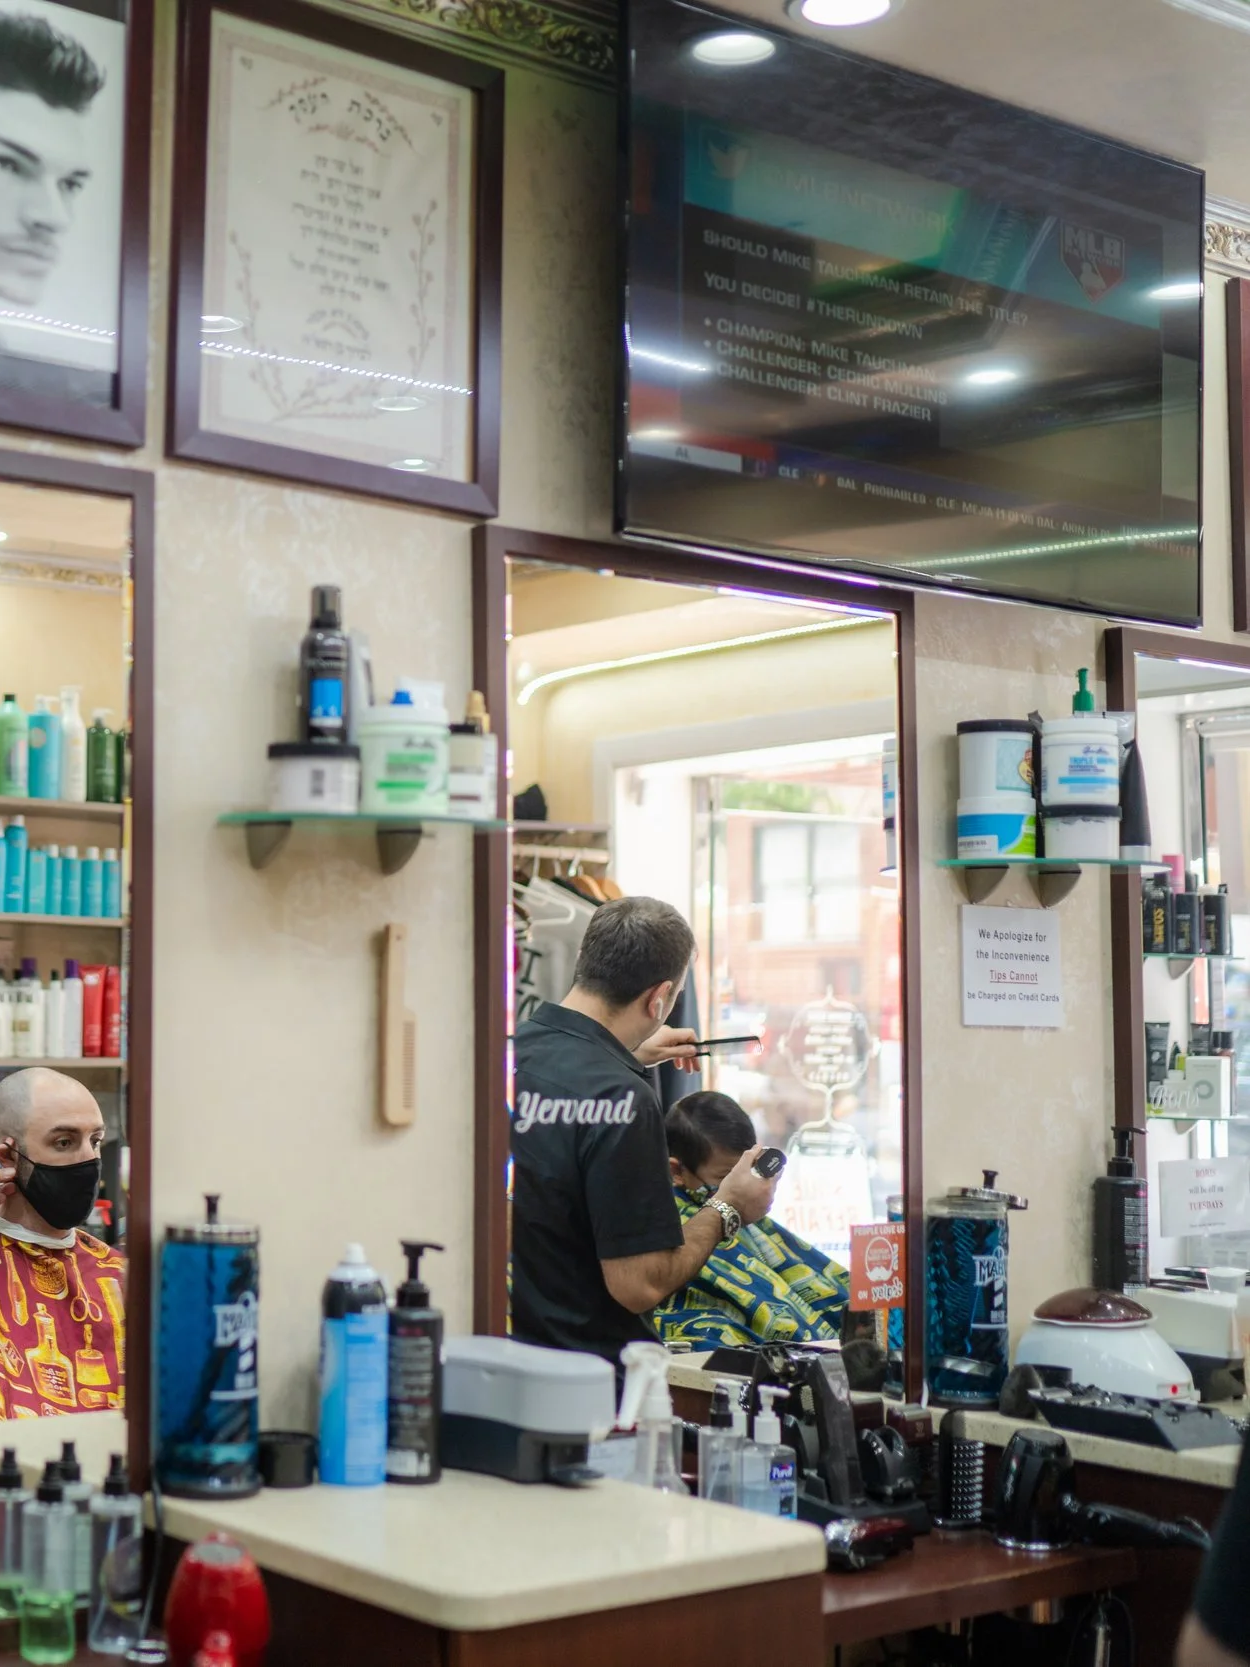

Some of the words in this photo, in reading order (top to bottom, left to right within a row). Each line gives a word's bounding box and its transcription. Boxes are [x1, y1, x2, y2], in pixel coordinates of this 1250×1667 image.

[1064, 224, 1123, 258] MLB
[703, 229, 767, 258] SHOULD
[773, 249, 811, 271] MIKE
[817, 259, 900, 294] TAUCHMAN
[904, 282, 952, 307] RETAIN
[958, 297, 983, 316] THE
[987, 304, 1029, 327] TITLE?
[704, 272, 737, 293] YOU
[742, 280, 801, 309] DECIDE!
[807, 297, 924, 340] #THERUNDOWN
[717, 318, 806, 352] CHAMPION:
[811, 339, 849, 362] MIKE
[855, 350, 937, 382] TAUCHMAN
[717, 340, 822, 376] CHALLENGER:
[827, 365, 881, 391] CEDRIC
[884, 380, 948, 405] MULLINS
[717, 362, 822, 397] CHALLENGER:
[827, 386, 868, 408] CLINT
[873, 395, 932, 422] FRAZIER
[779, 465, 800, 479] CLE
[978, 929, 991, 939] We
[993, 930, 1033, 943] Apologize
[1035, 932, 1047, 942] for
[976, 949, 989, 959] the
[992, 950, 1050, 962] Inconvenience
[990, 969, 1007, 982] Tips
[1010, 970, 1038, 982] Cannot
[967, 991, 976, 1000] be
[978, 991, 1007, 1002] Charged
[1018, 992, 1039, 1001] Credit
[1040, 993, 1060, 1002] Cards
[1151, 1085, 1200, 1110] Boris
[514, 1090, 637, 1133] Yervand
[1188, 1200, 1224, 1211] TUESDAYS
[854, 1226, 879, 1236] PEOPLE
[879, 1224, 895, 1235] LOVE
[896, 1223, 906, 1234] US
